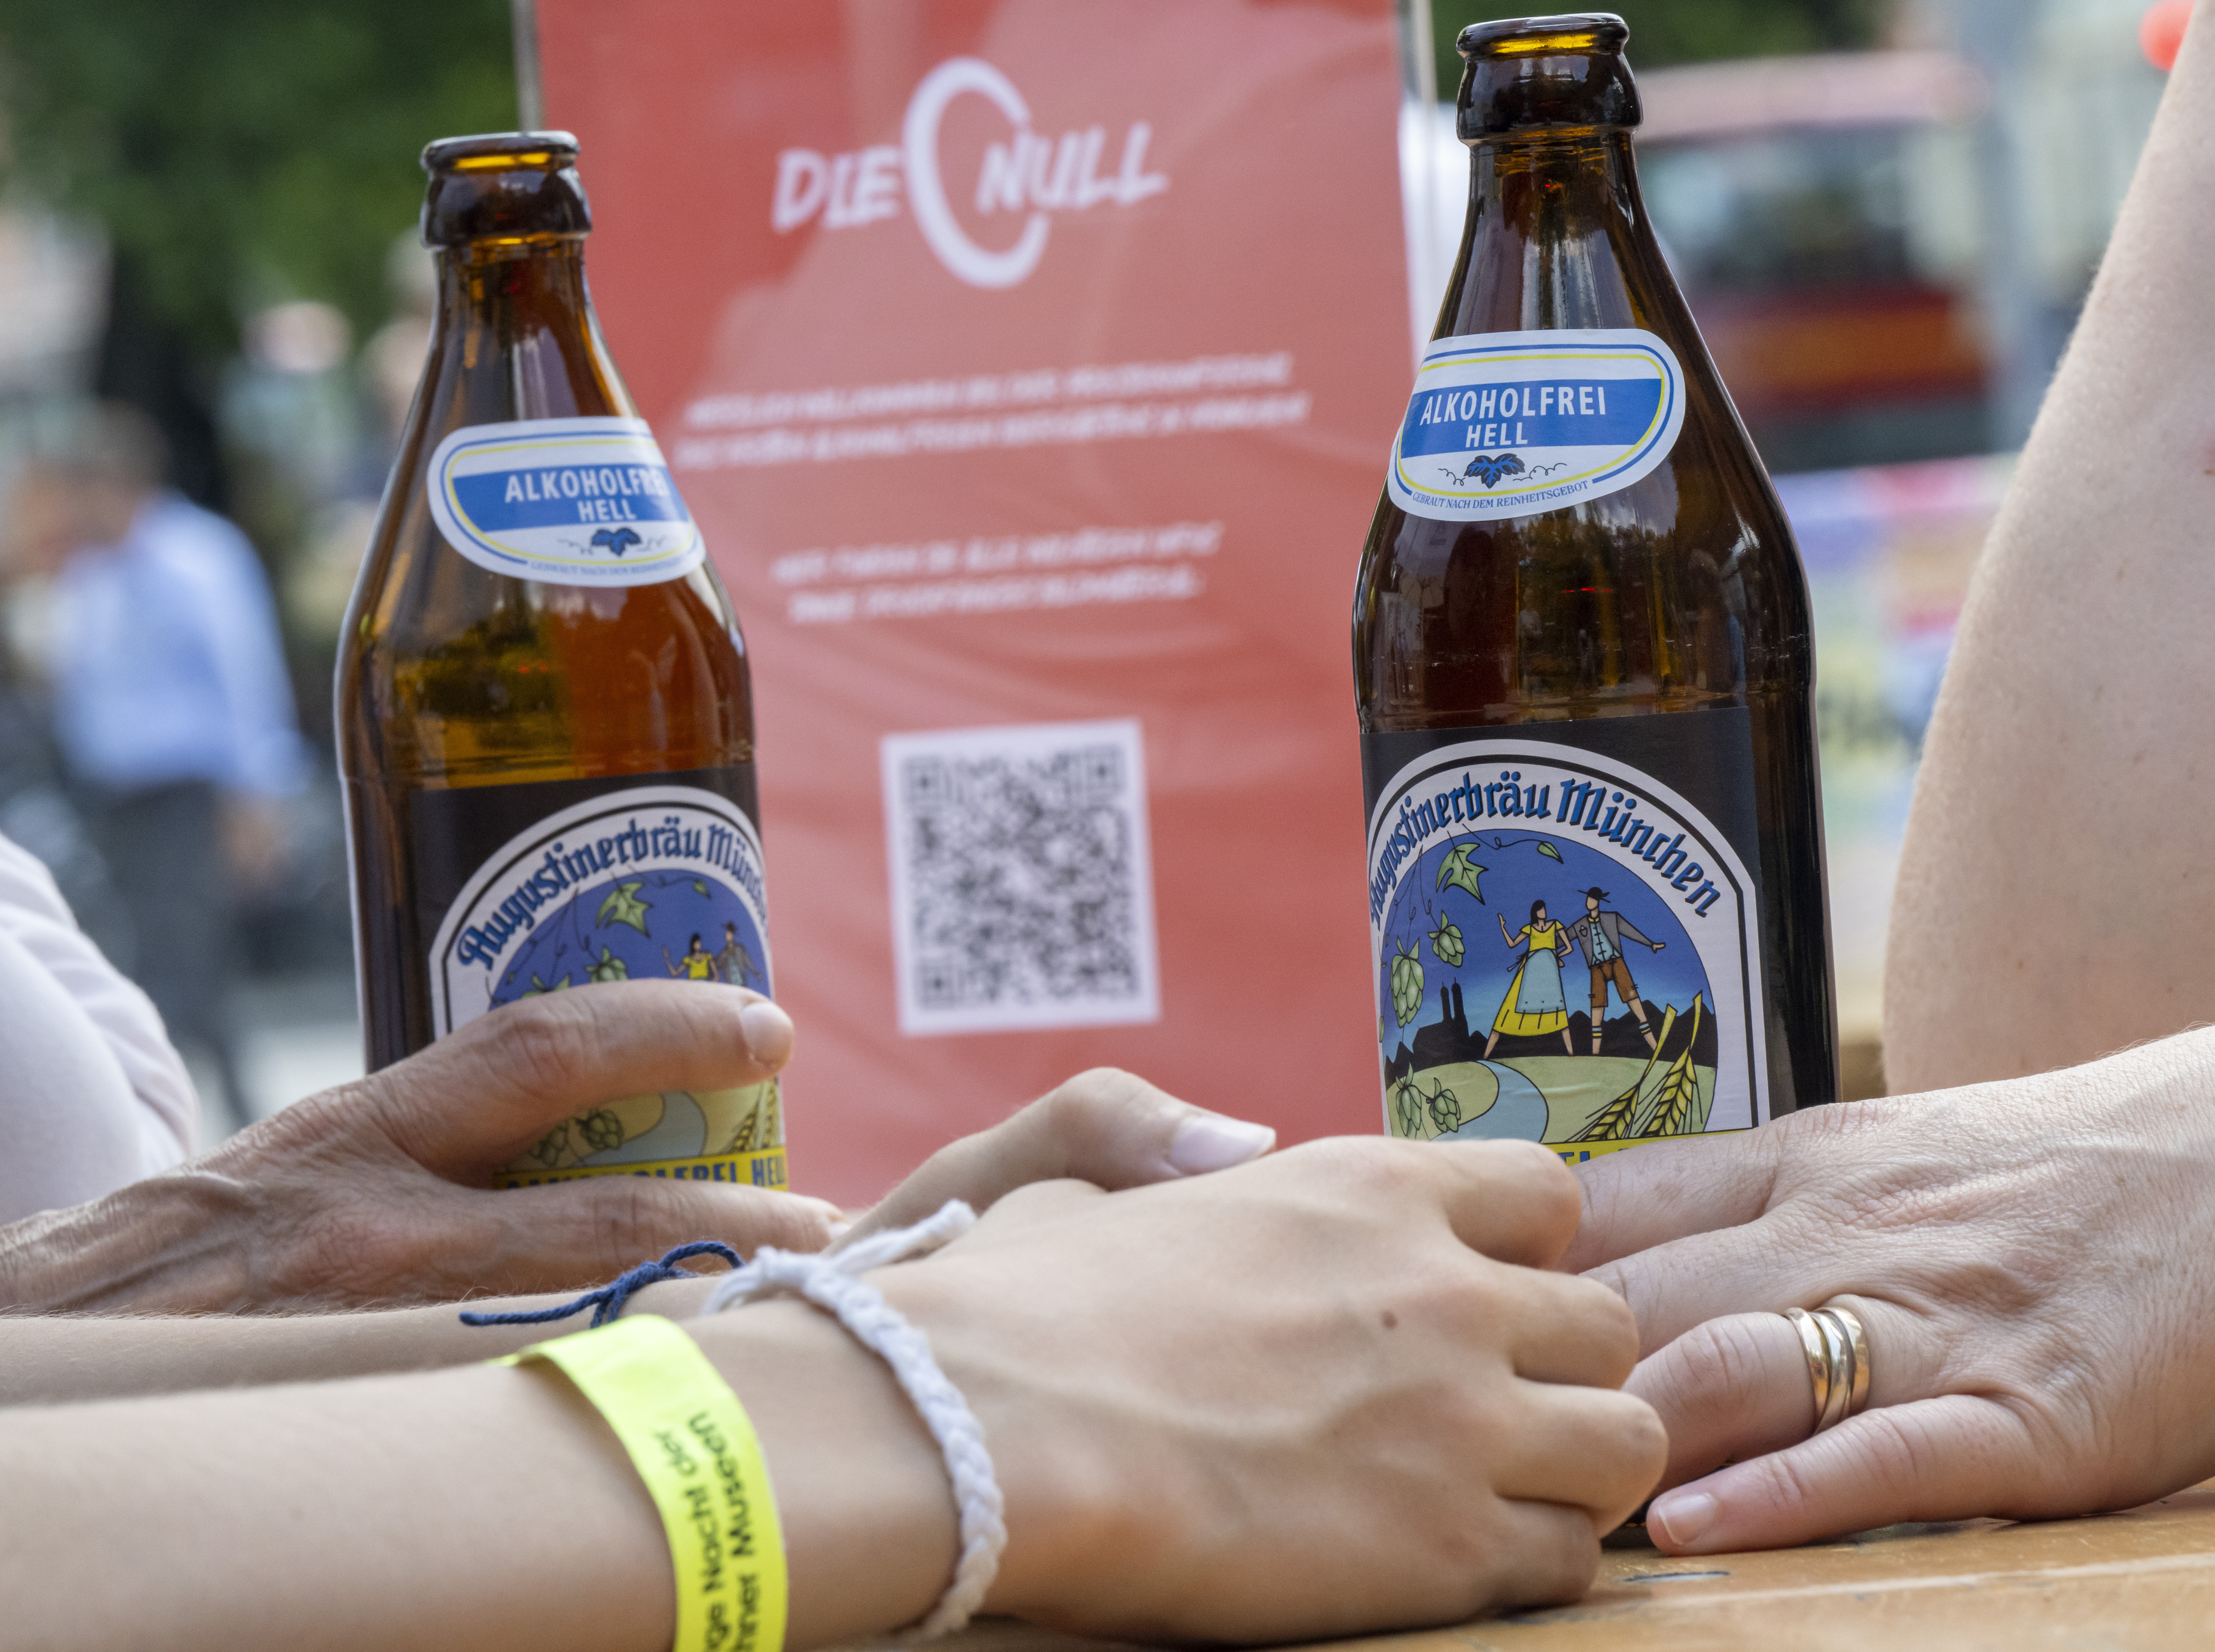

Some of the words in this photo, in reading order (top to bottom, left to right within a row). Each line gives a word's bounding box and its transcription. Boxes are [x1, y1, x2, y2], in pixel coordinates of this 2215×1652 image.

[772, 145, 900, 233] DIE
[975, 120, 1170, 215] NULL
[1420, 387, 1606, 425] ALKOHOLFREI
[1465, 422, 1528, 447] HELL
[578, 498, 637, 522] HELL
[1412, 492, 1446, 508] GEBRAUT
[1445, 498, 1470, 509] NACH
[1472, 498, 1494, 509] DEM
[1496, 480, 1589, 508] REINHEITSGEBOT
[1370, 770, 1552, 931] Augustinerbräu
[1555, 778, 1722, 918] München
[456, 816, 702, 971] Augustinerbräu
[652, 1429, 698, 1477] der
[689, 1411, 756, 1559] Museen
[683, 1485, 727, 1596] Nacht
